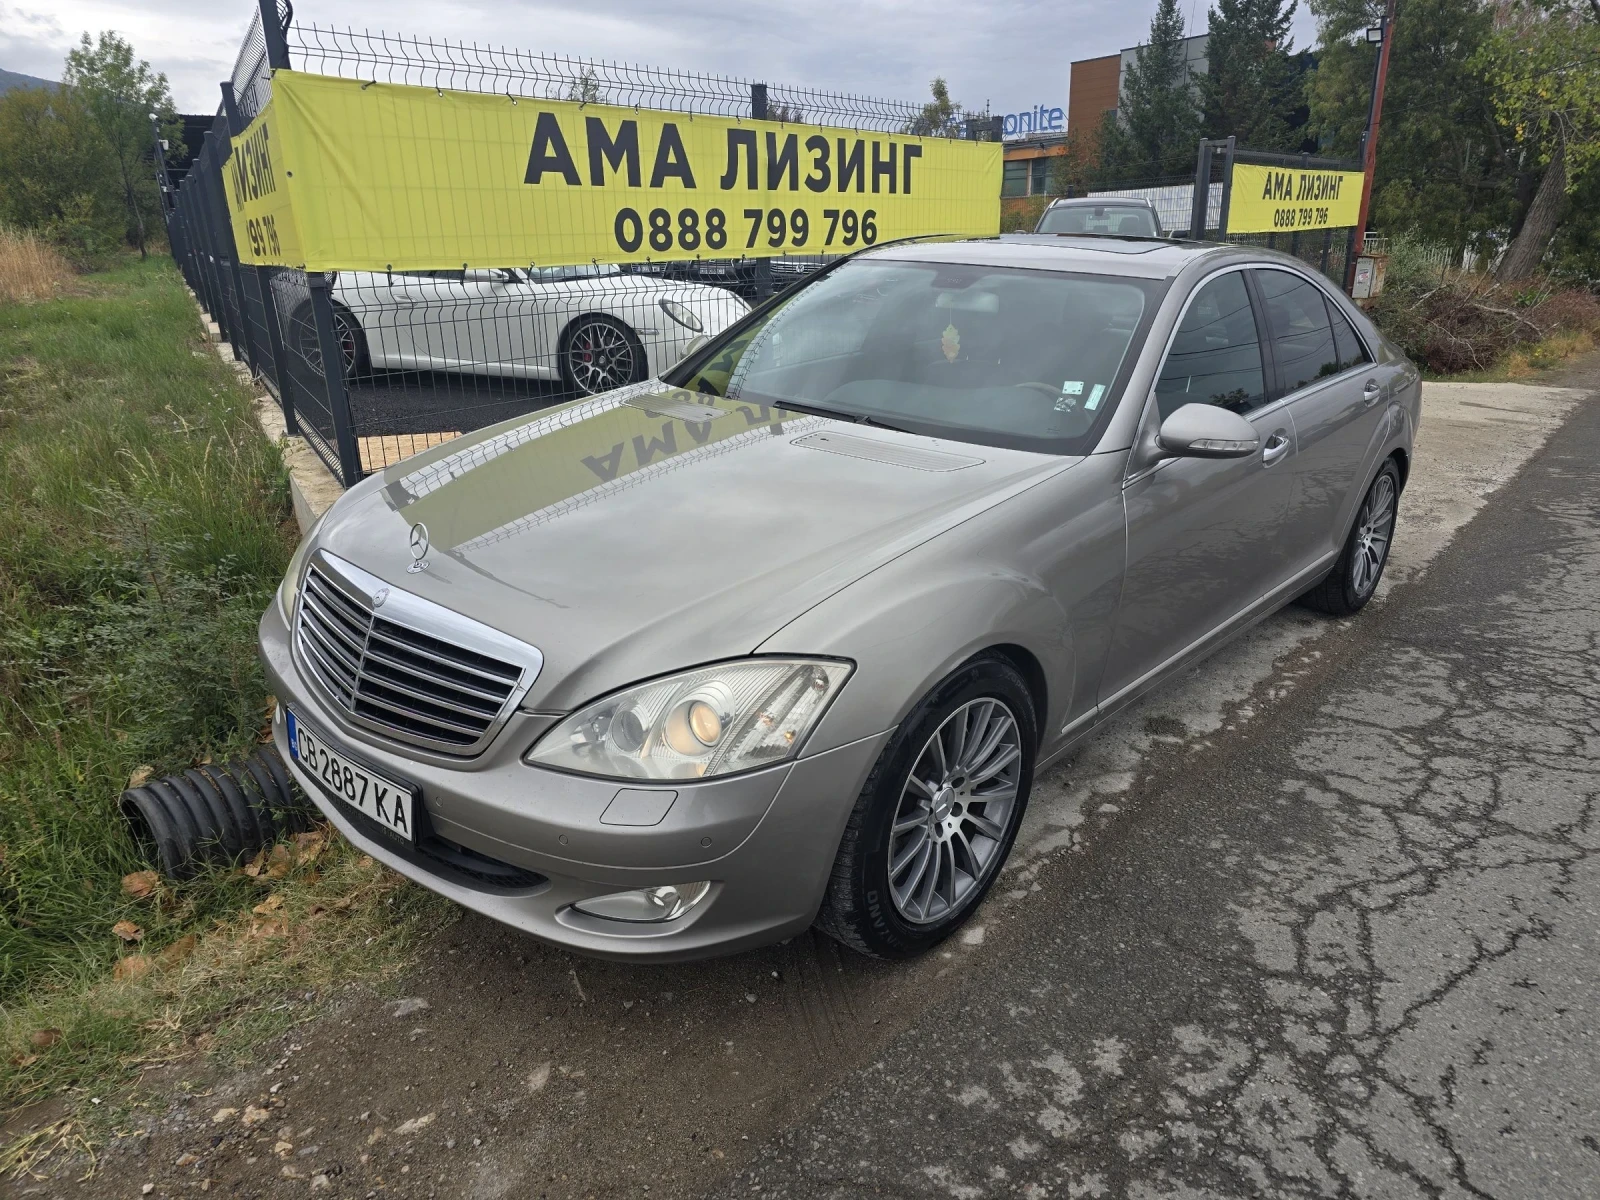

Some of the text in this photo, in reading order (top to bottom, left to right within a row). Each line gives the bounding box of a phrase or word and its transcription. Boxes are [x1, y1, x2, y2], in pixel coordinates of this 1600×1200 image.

[1003, 104, 1063, 135] onite
[524, 112, 923, 195] АМА ЛИЗИНГ
[1262, 171, 1343, 201] АМА ЛИЗИНГ
[615, 207, 877, 253] 0888 799 796
[1274, 207, 1328, 227] 0888 799 796
